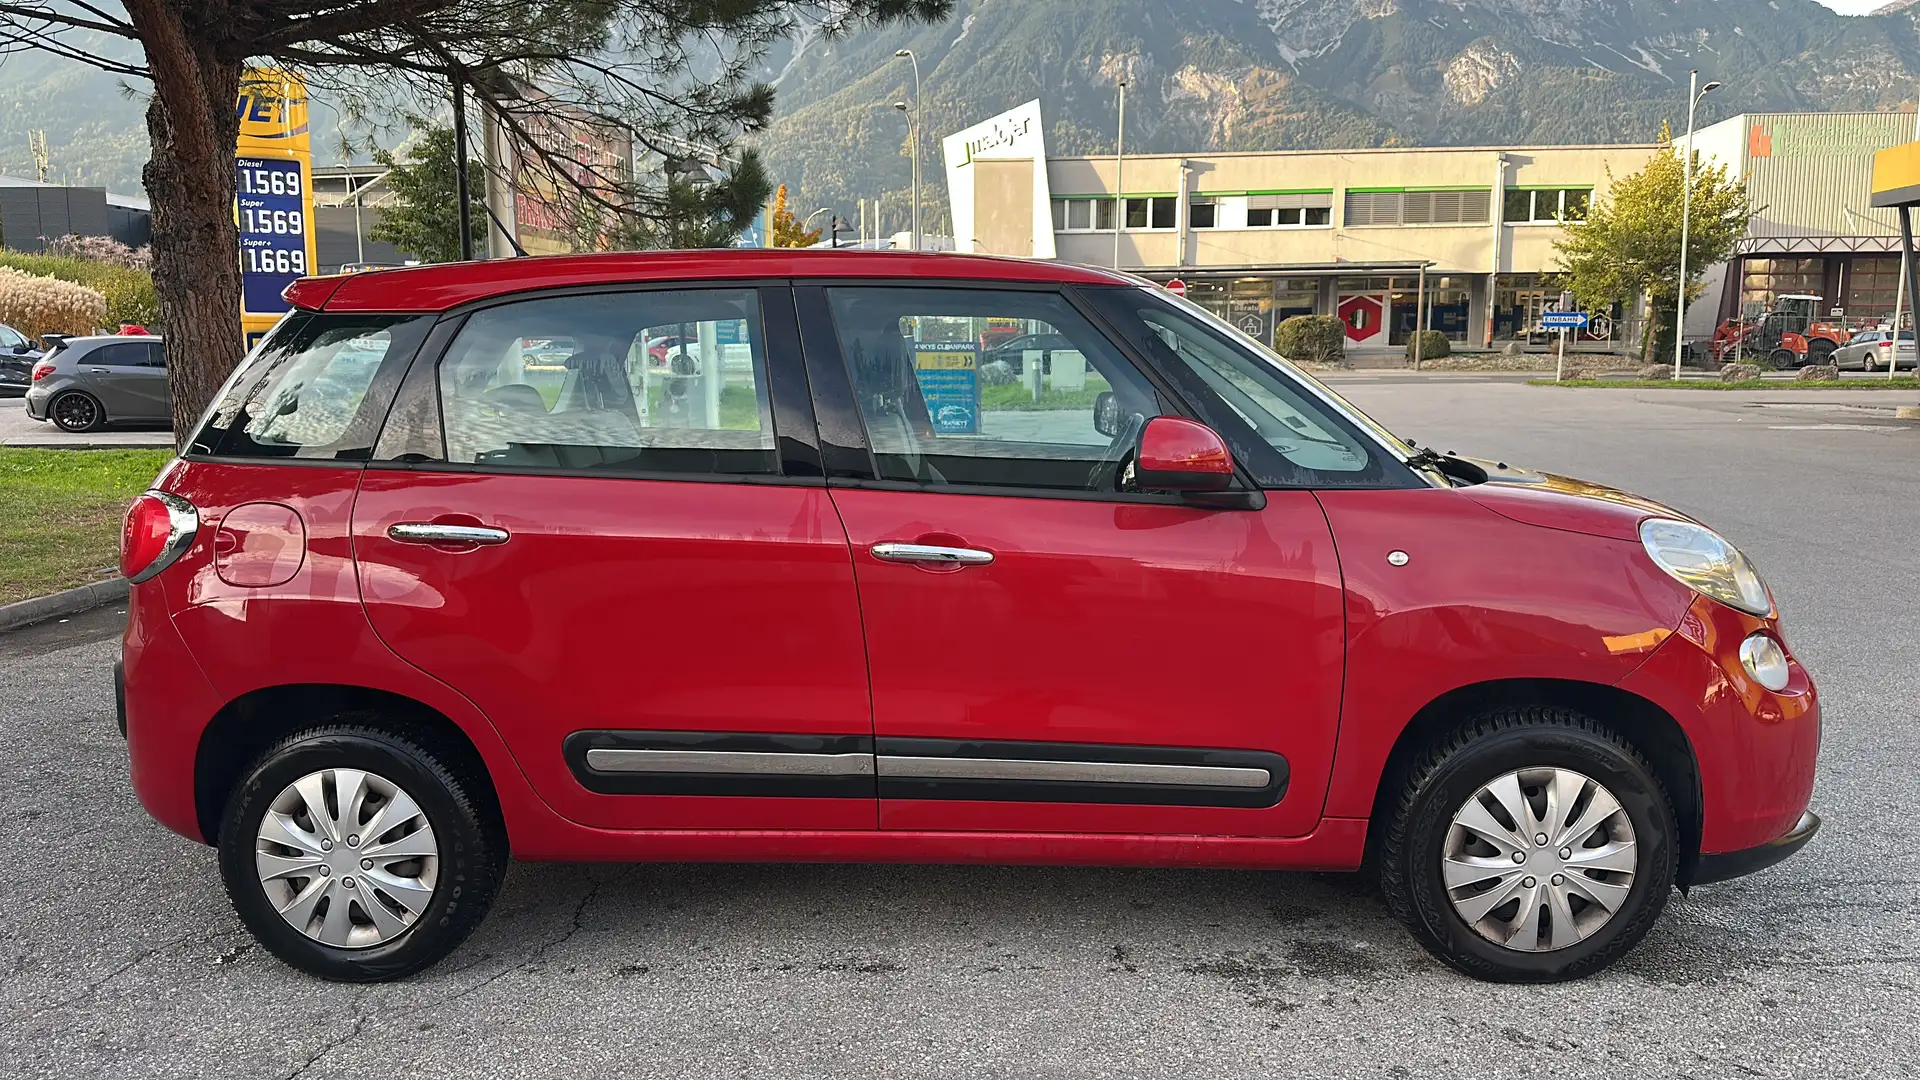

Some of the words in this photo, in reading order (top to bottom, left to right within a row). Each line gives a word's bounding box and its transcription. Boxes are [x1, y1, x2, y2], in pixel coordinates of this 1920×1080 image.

[238, 159, 263, 168] Diesel
[243, 169, 300, 196] 1.569
[240, 199, 264, 207] Super
[246, 209, 302, 235] 1.569
[243, 239, 272, 247] Super+
[248, 248, 305, 273] 1.669
